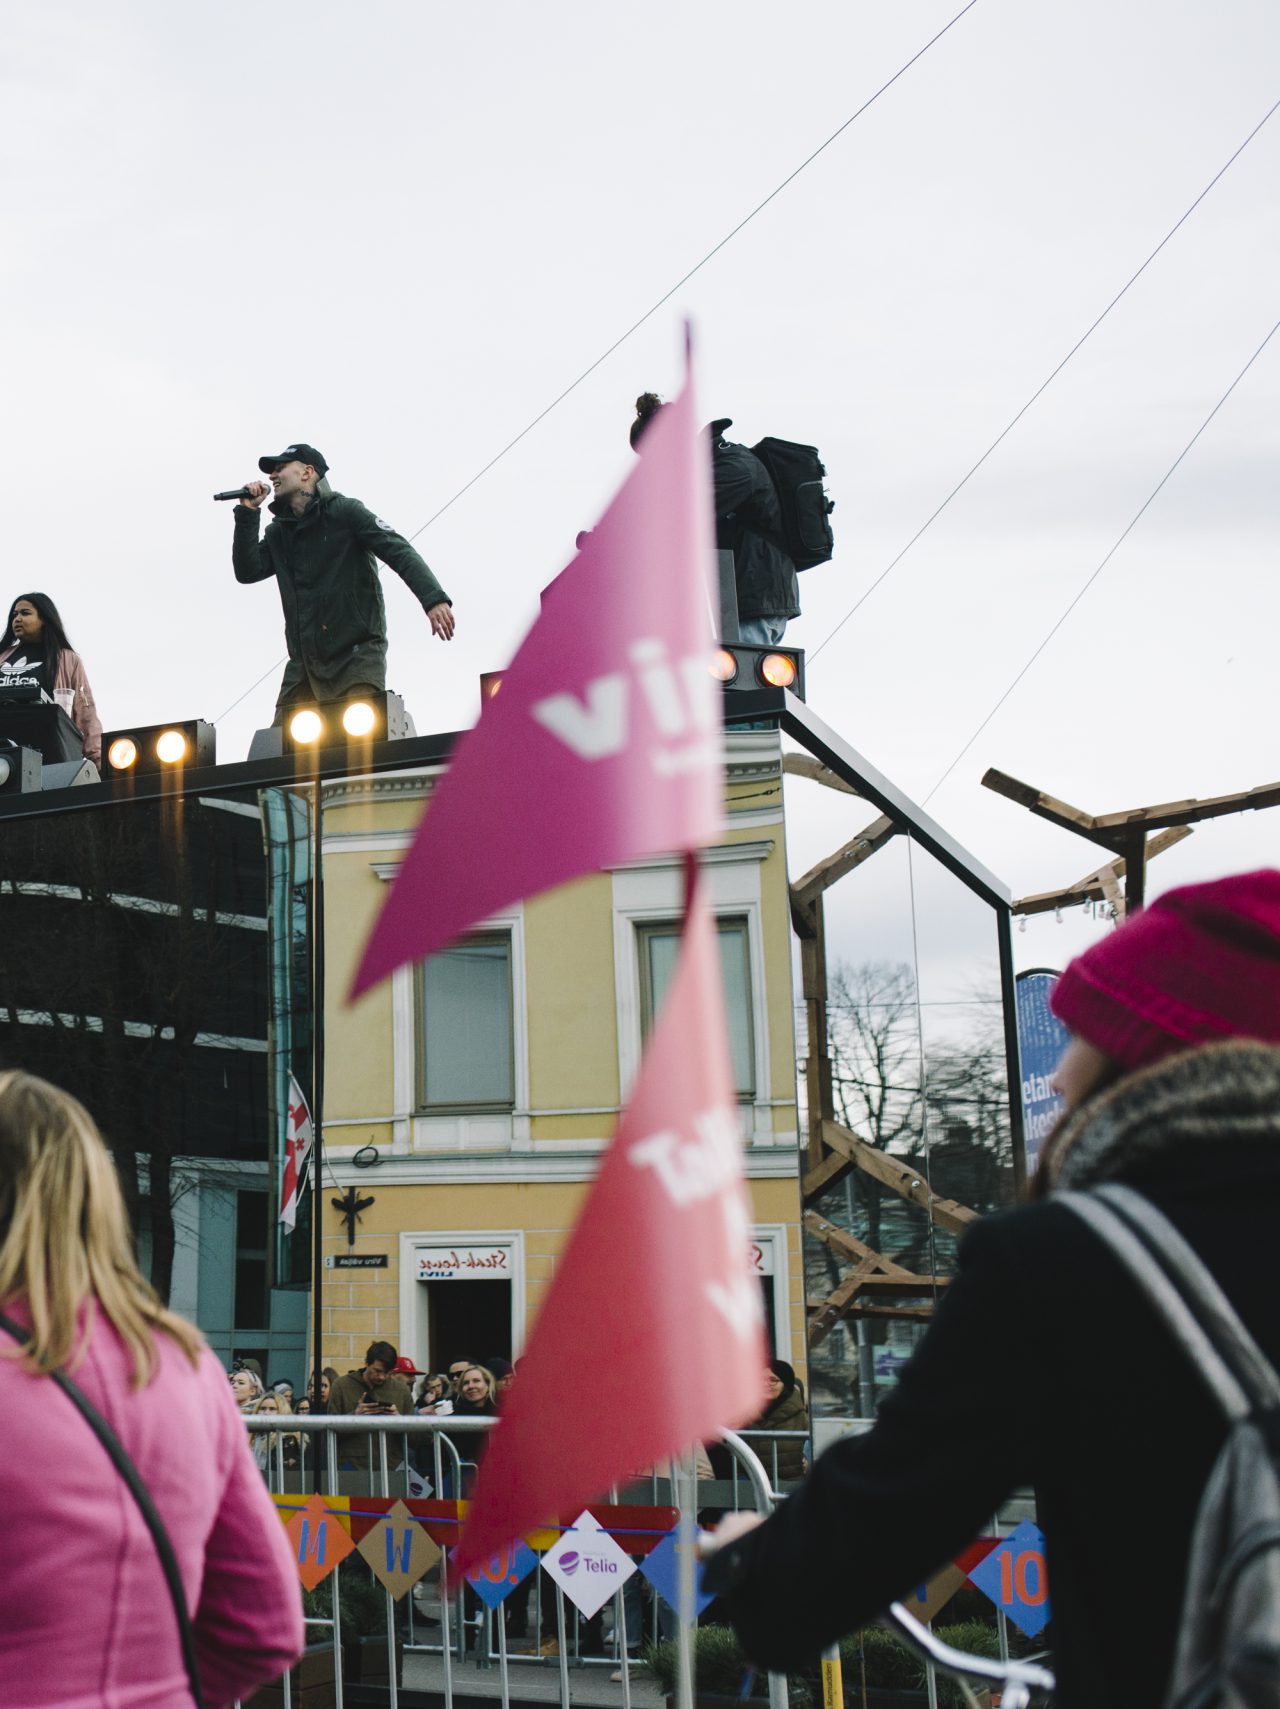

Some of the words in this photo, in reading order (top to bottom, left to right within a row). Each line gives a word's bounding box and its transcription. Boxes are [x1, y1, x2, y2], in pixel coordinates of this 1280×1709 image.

[298, 1518, 327, 1565] M
[385, 1527, 412, 1575] W
[583, 1557, 618, 1574] Telia
[997, 1550, 1048, 1606] 10
